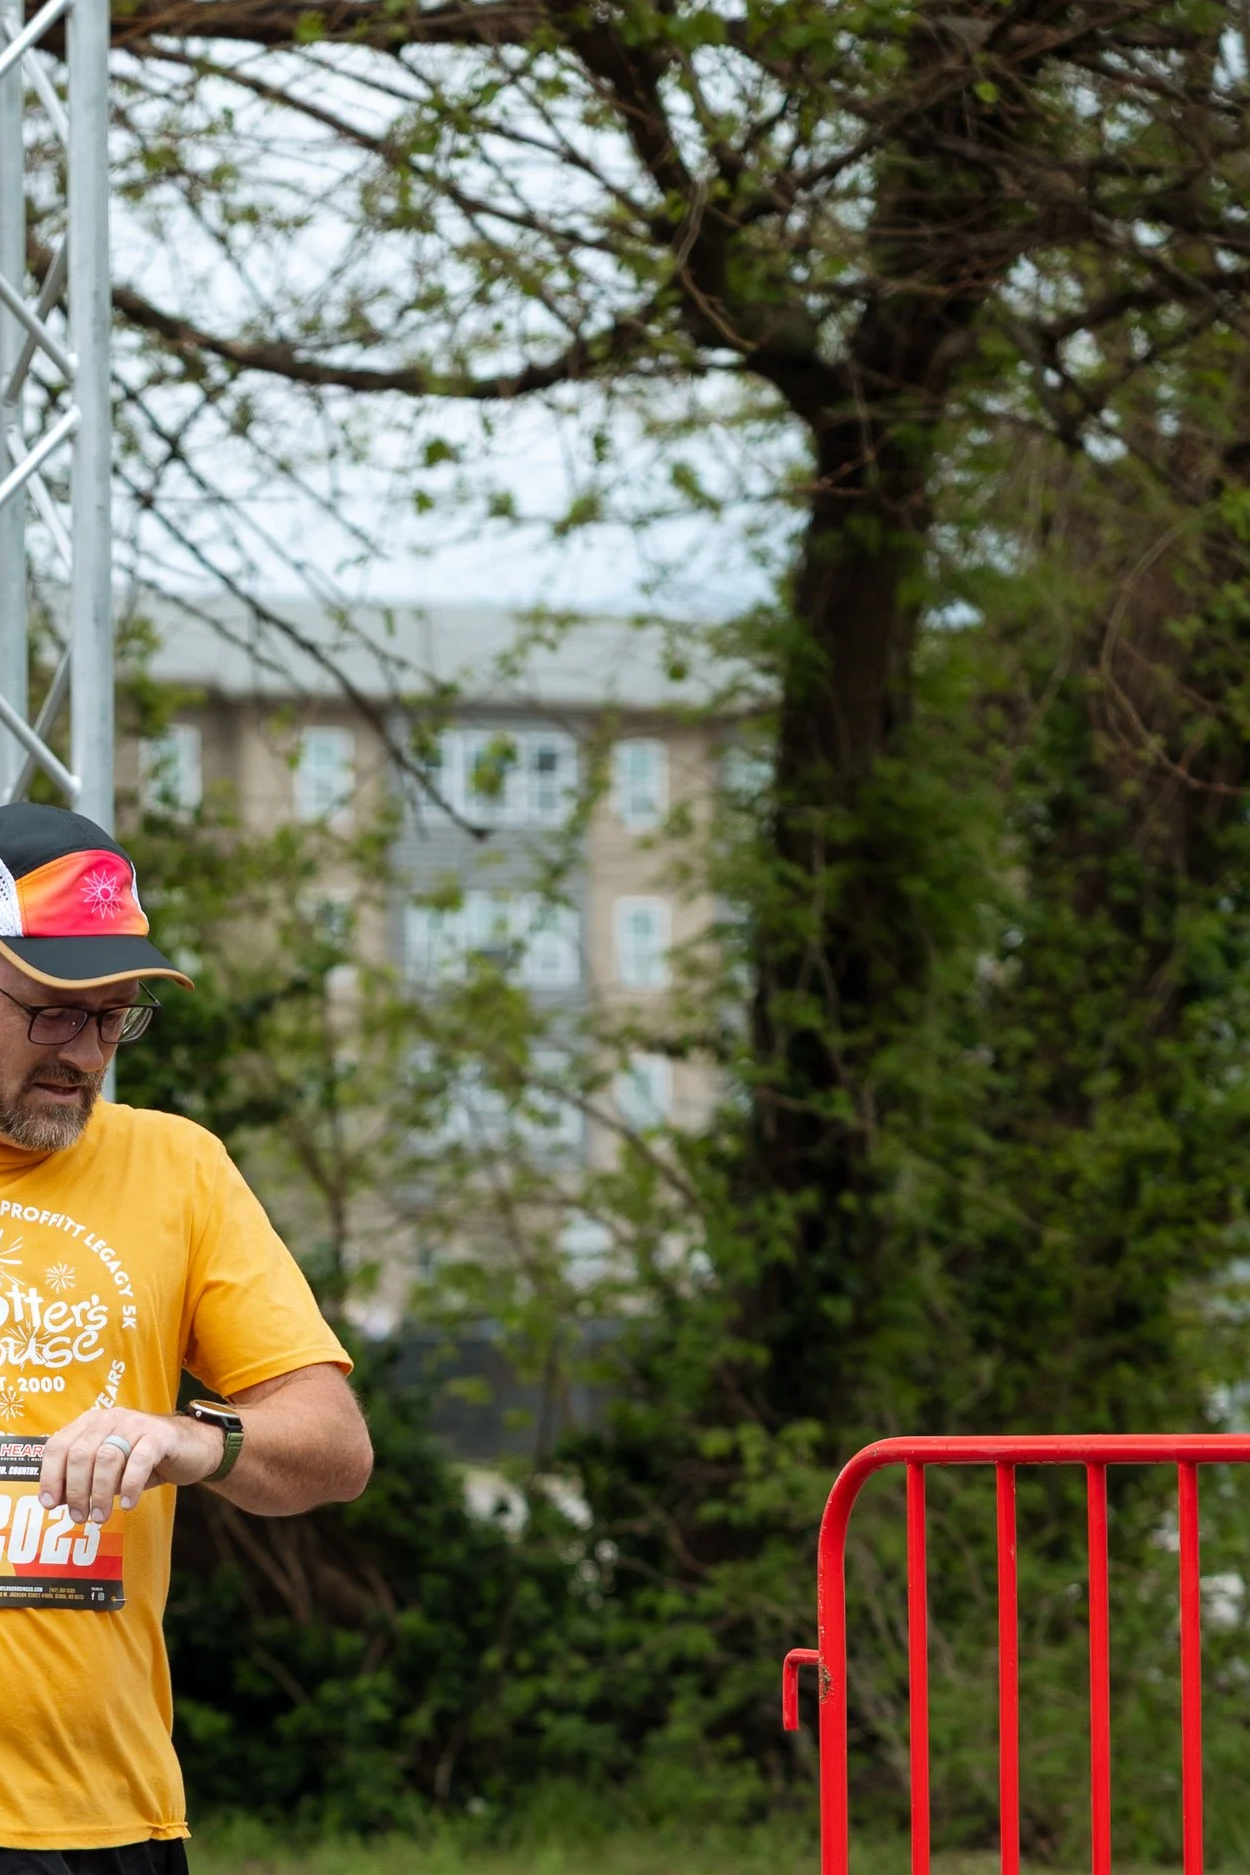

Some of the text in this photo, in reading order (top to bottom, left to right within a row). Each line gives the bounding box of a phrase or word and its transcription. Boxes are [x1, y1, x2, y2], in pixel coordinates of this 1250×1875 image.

[0, 1199, 86, 1237] PROFFITT
[83, 1232, 134, 1298] LEGACY
[121, 1304, 137, 1329] 5K
[18, 1375, 66, 1393] 2000
